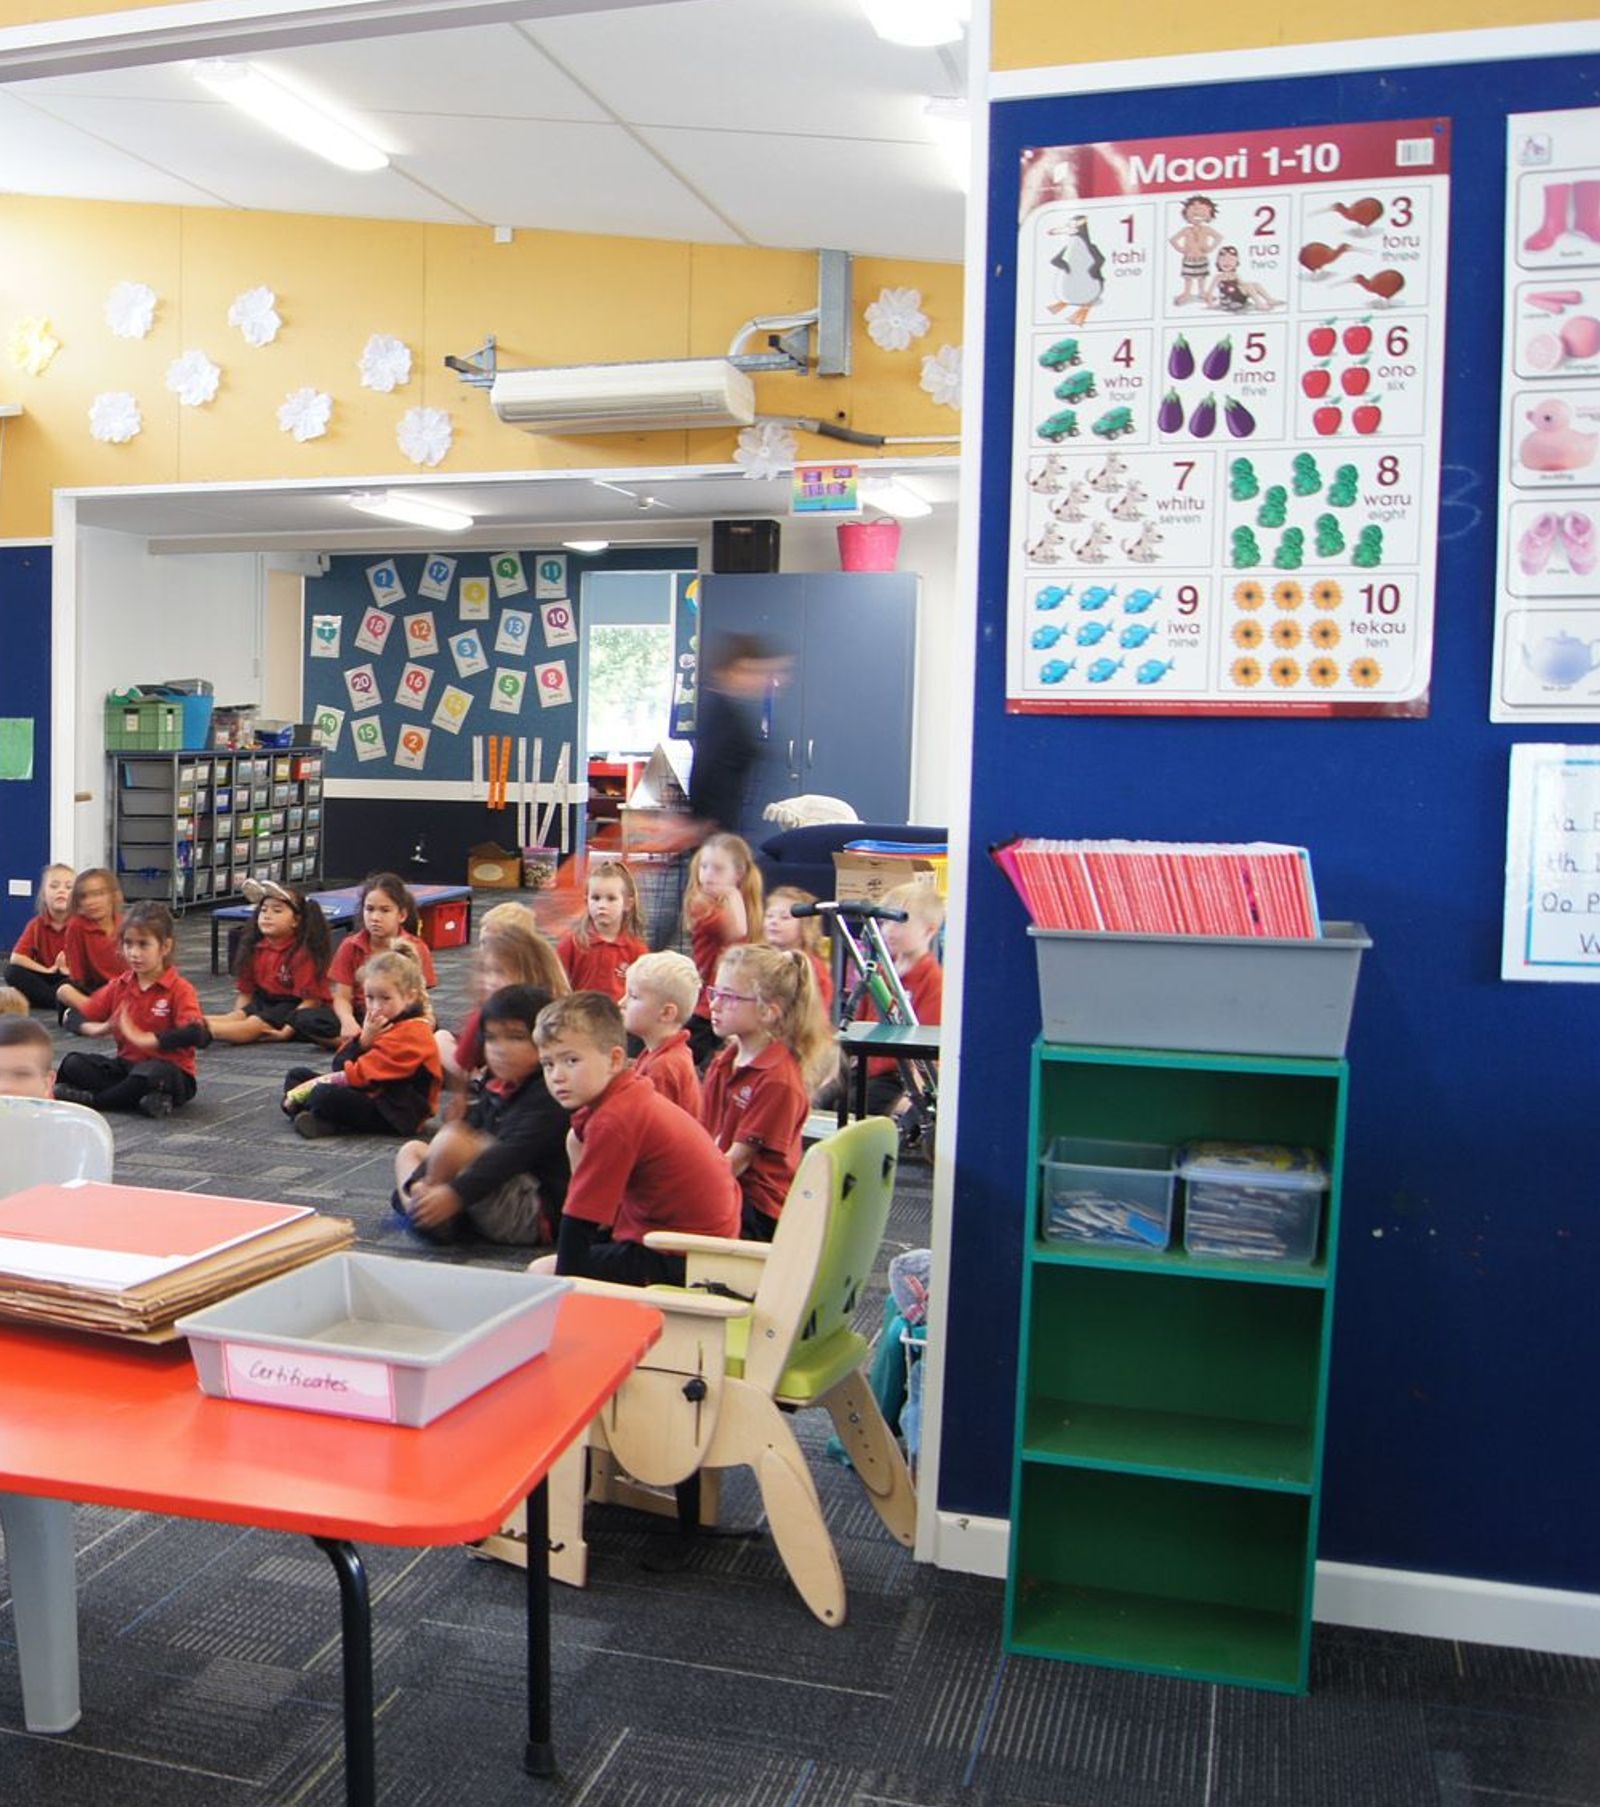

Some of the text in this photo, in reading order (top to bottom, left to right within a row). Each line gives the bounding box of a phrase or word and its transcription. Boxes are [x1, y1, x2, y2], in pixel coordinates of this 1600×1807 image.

[1128, 142, 1341, 186] Maori 1-10
[1389, 196, 1413, 228] 3
[1254, 206, 1276, 236] 2
[1120, 214, 1135, 244] 1
[1249, 242, 1281, 257] rua
[1382, 234, 1421, 250] toru
[1111, 248, 1146, 265] tahi
[1382, 249, 1420, 263] three
[1114, 266, 1142, 278] one
[1250, 258, 1278, 271] two
[1244, 333, 1267, 363] 5
[1386, 326, 1409, 357] 6
[1112, 339, 1135, 368] 4
[1233, 368, 1276, 385] rima
[1377, 363, 1416, 379] ono
[1103, 371, 1143, 389] wha
[1387, 378, 1406, 392] six
[1109, 388, 1136, 402] four
[1241, 384, 1268, 398] five
[1173, 461, 1196, 491] 7
[1376, 456, 1400, 486] 8
[1156, 495, 1205, 512] whitu
[1363, 492, 1412, 507] waru
[1159, 513, 1202, 525] seven
[1368, 507, 1407, 523] eight
[1177, 586, 1199, 615] 9
[1359, 584, 1401, 614] 10
[549, 610, 566, 624] 10
[413, 623, 428, 636] 12
[507, 620, 522, 634] 13
[1167, 621, 1201, 635] iwa
[1350, 619, 1406, 636] tekau
[1168, 636, 1199, 649] nine
[1365, 636, 1389, 649] ten
[353, 676, 370, 690] 20
[408, 674, 423, 687] 16
[504, 679, 514, 691] 5
[359, 727, 375, 741] 15
[409, 735, 418, 747] 2
[249, 1359, 348, 1393] Certificates
